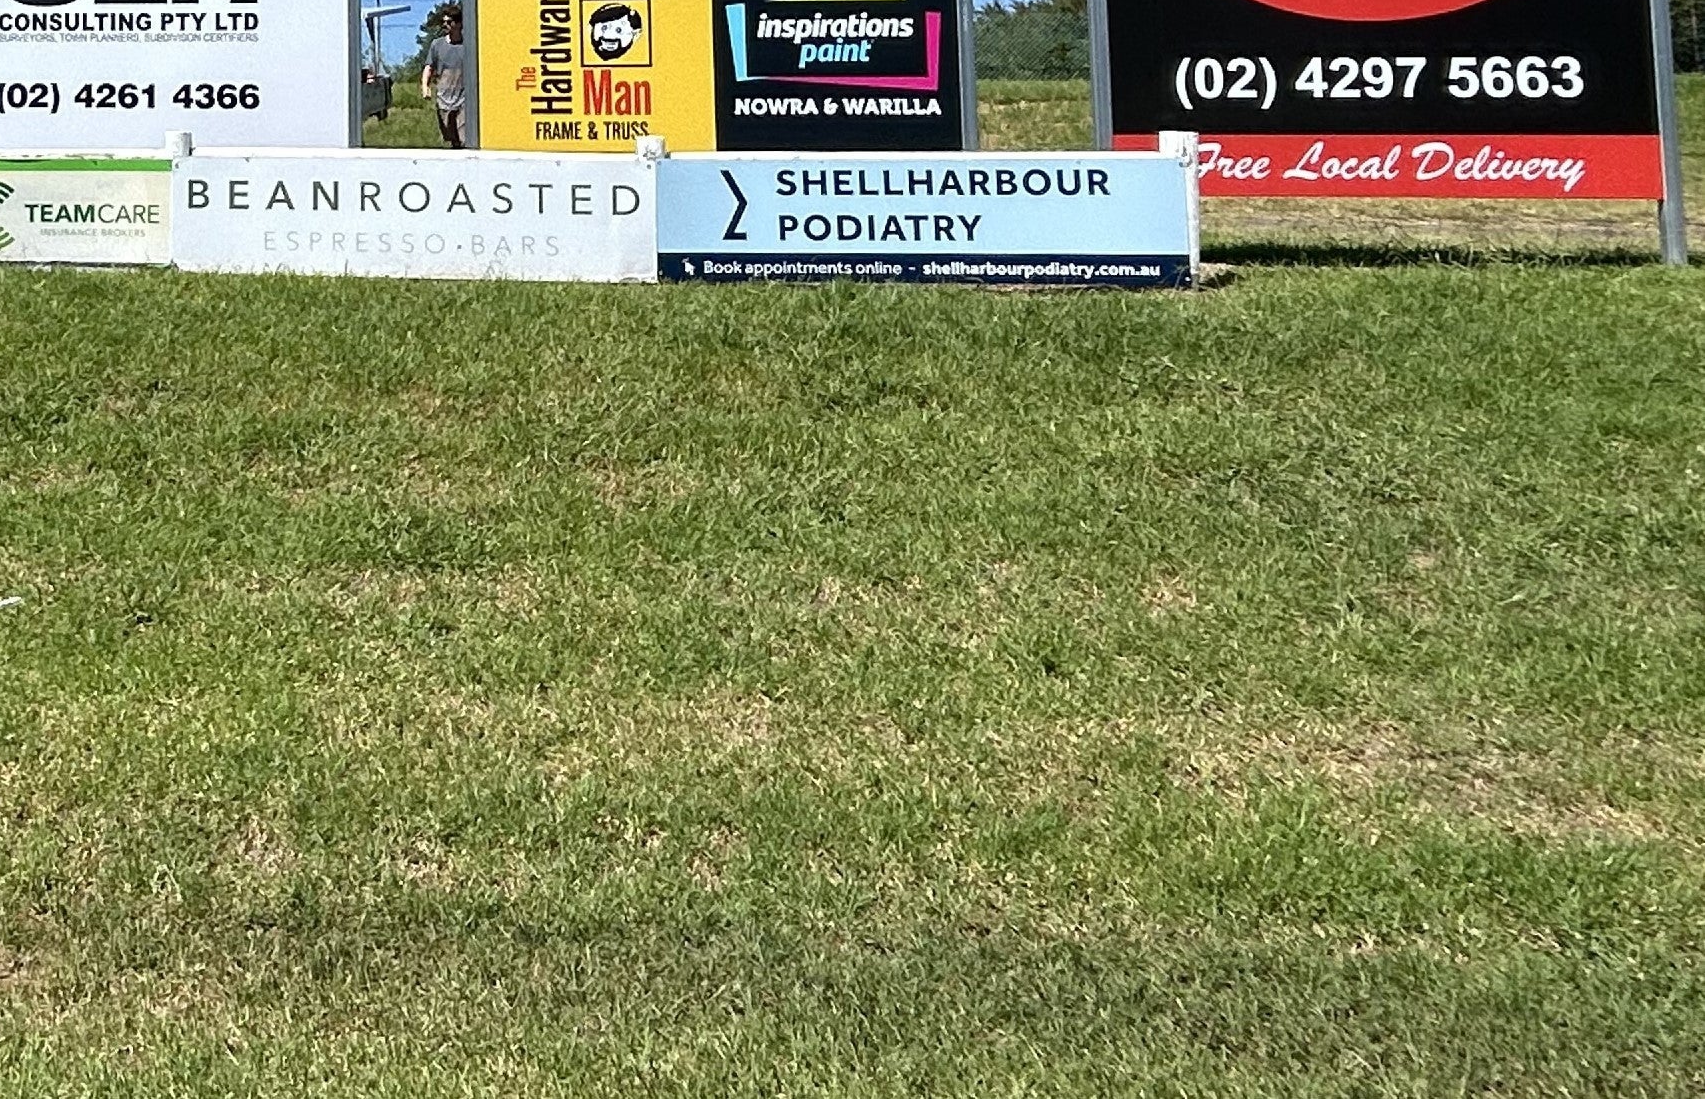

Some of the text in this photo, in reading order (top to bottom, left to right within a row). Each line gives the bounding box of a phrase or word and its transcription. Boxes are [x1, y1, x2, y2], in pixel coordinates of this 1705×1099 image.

[160, 13, 207, 32] PTY
[215, 13, 259, 32] LTD
[756, 12, 914, 44] inspirations
[798, 37, 871, 69] paint
[516, 66, 537, 91] The
[1174, 55, 1584, 110] (02) 4297 5663
[74, 83, 156, 110] 4261
[173, 83, 260, 110] 4366
[583, 69, 651, 115] Man
[734, 98, 942, 115] NOWRA & WARILLA
[535, 120, 649, 140] FRAME & TRUSS
[1197, 141, 1585, 192] Free Local Delivery
[776, 170, 1110, 196] SHELLHARBOUR
[188, 180, 641, 216] BEANROASTED
[25, 203, 160, 224] TEAMCARE
[40, 228, 146, 237] INSURANCE BROKERS
[779, 214, 982, 241] PODIATRY
[703, 260, 1161, 279] Book appointments online shellharbourpodiatry.com.au
